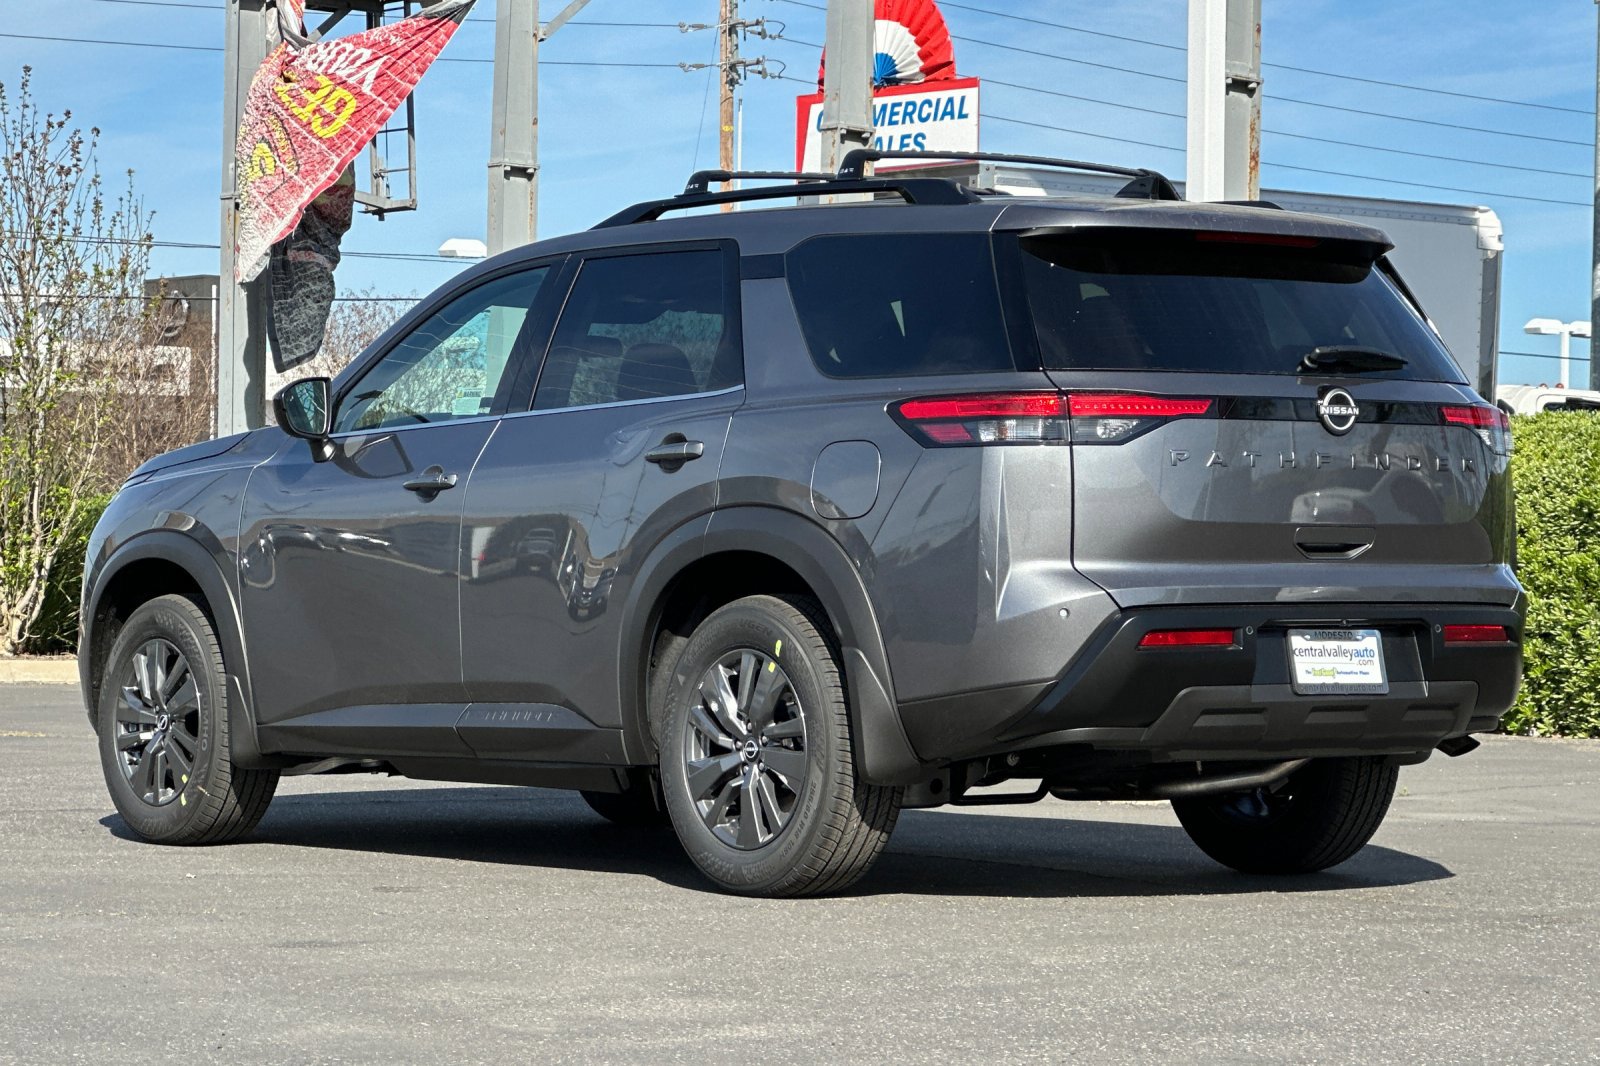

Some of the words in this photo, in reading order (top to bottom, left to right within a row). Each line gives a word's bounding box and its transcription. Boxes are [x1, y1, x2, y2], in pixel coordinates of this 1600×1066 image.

[817, 95, 969, 133] MERCIAL
[874, 131, 927, 152] ALES
[1320, 406, 1359, 415] NISSAN
[1169, 449, 1476, 472] PATHFINDER
[1314, 631, 1353, 640] MODESTO
[1293, 645, 1375, 661] centralvalleyauto
